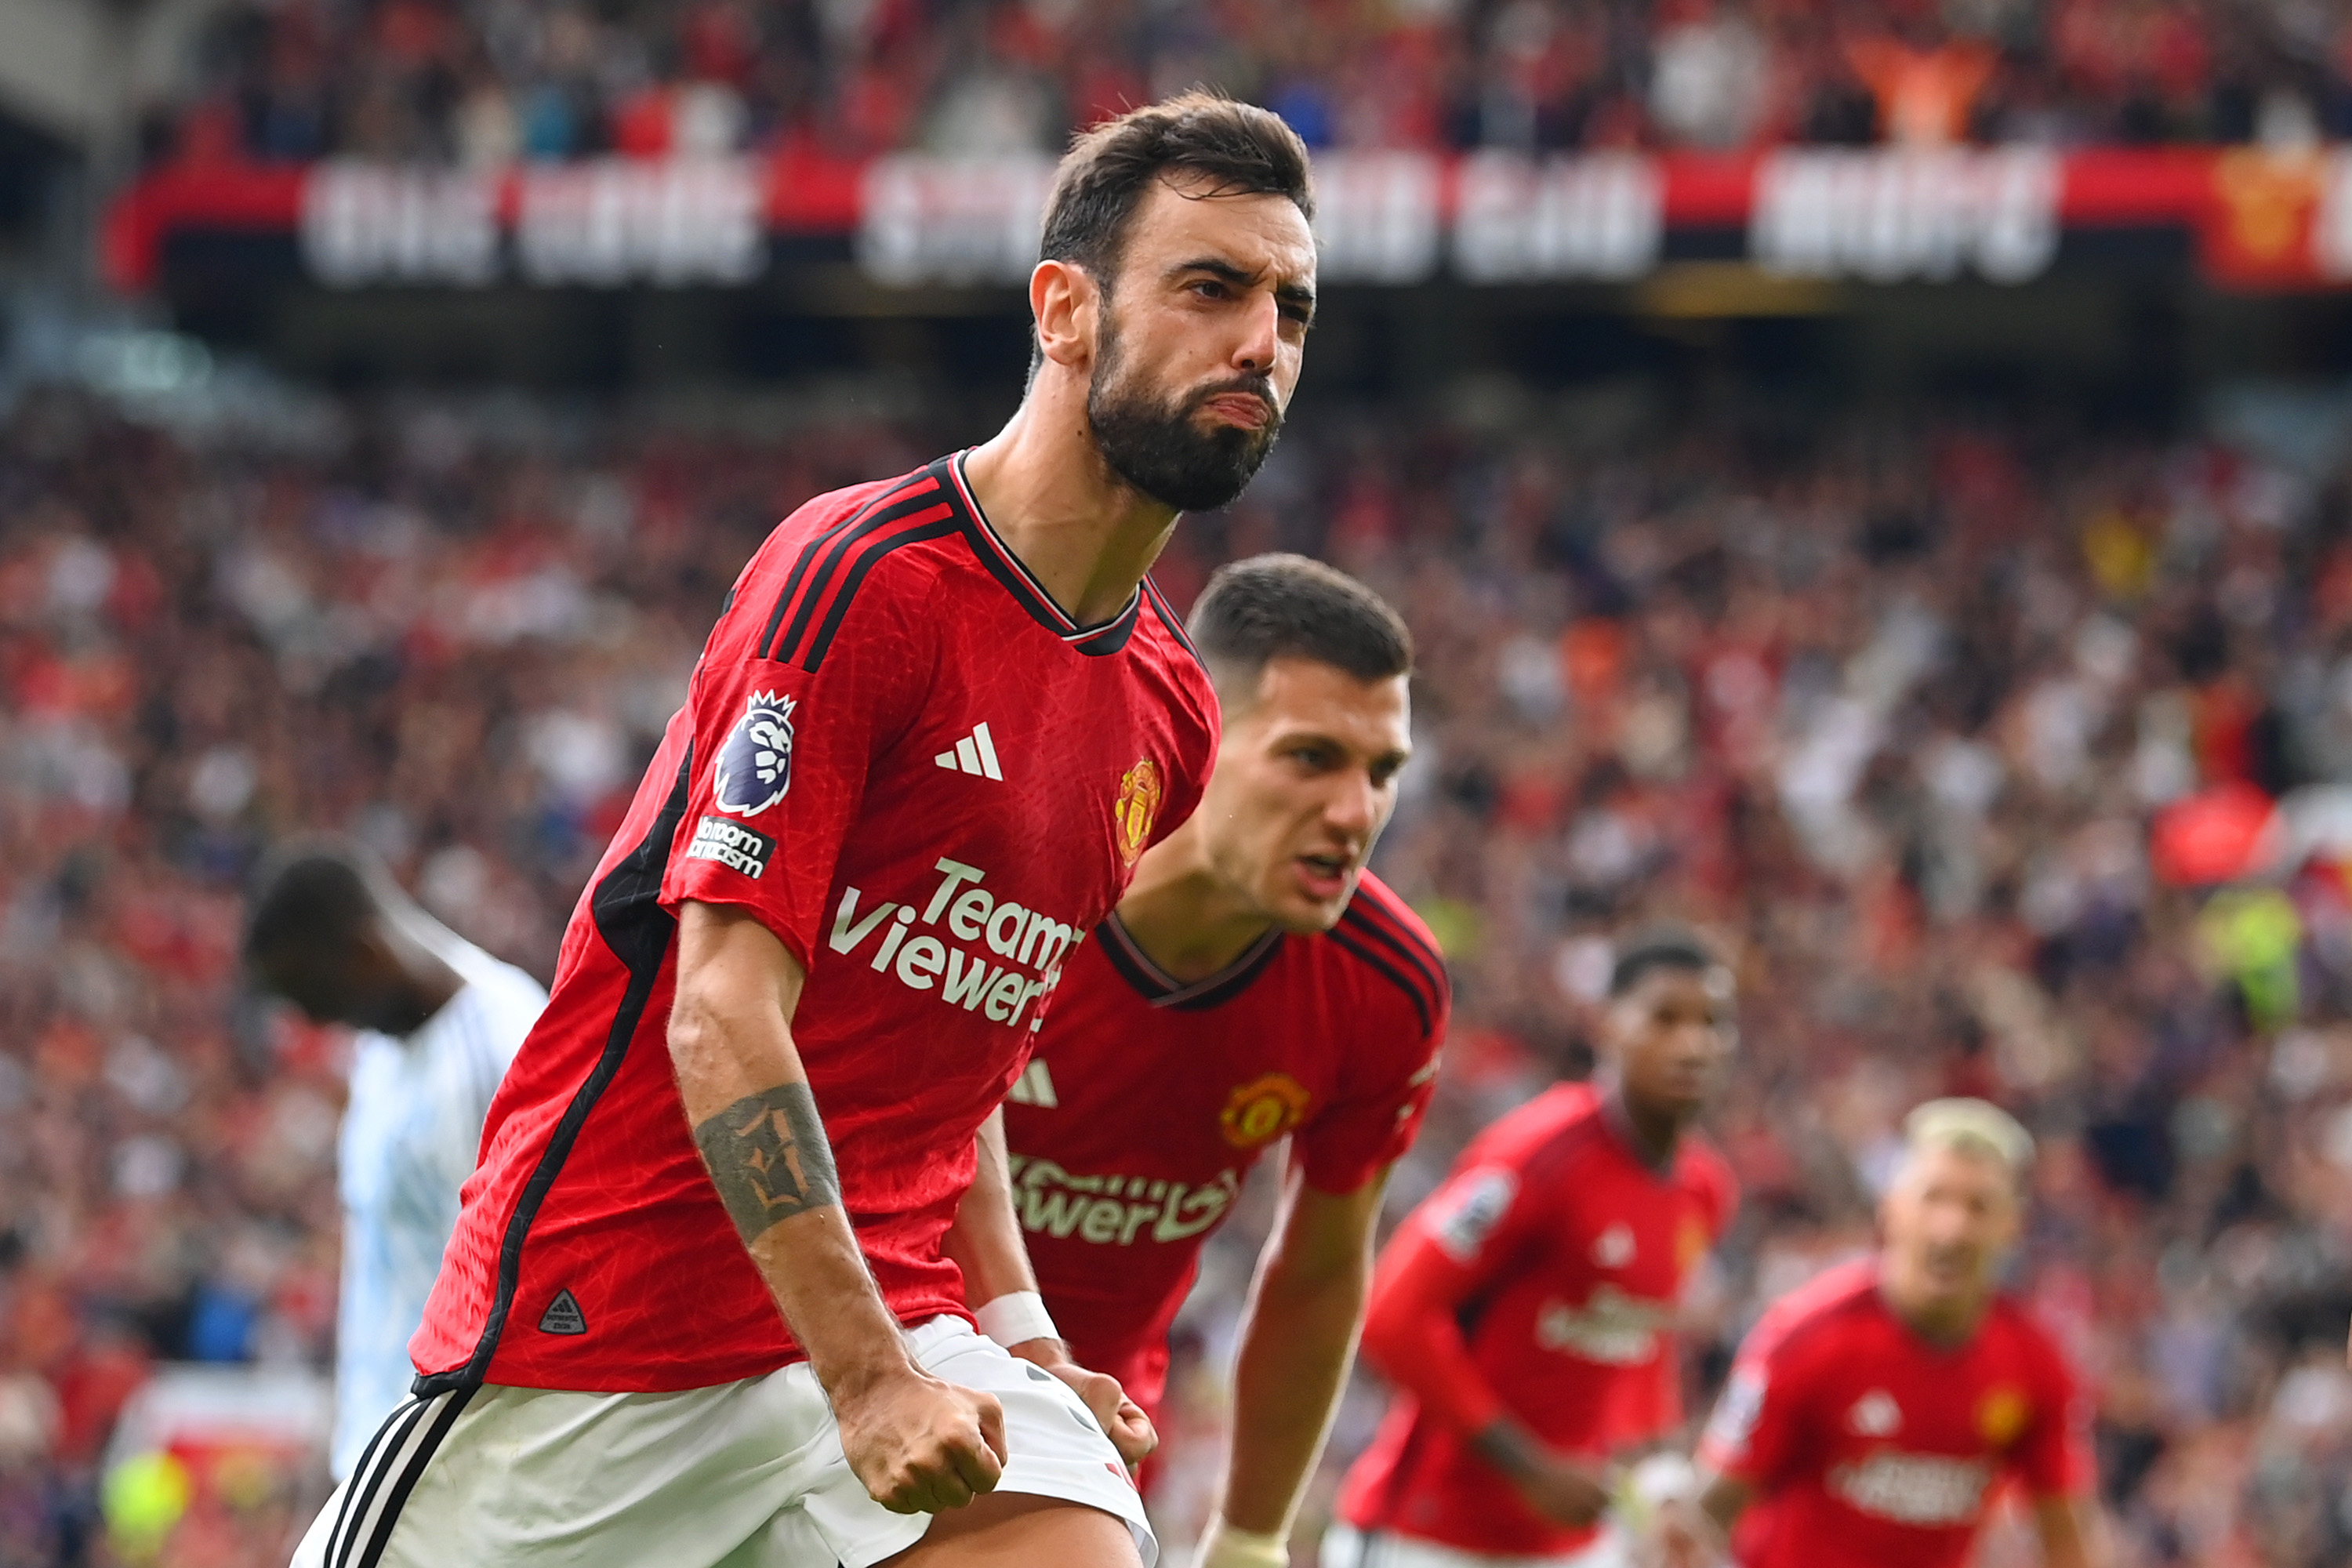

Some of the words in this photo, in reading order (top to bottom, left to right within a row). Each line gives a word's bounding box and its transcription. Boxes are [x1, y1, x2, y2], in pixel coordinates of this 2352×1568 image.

[828, 885, 1045, 1027] Viewer
[921, 856, 1073, 971] Team
[1011, 1185, 1160, 1246] wer
